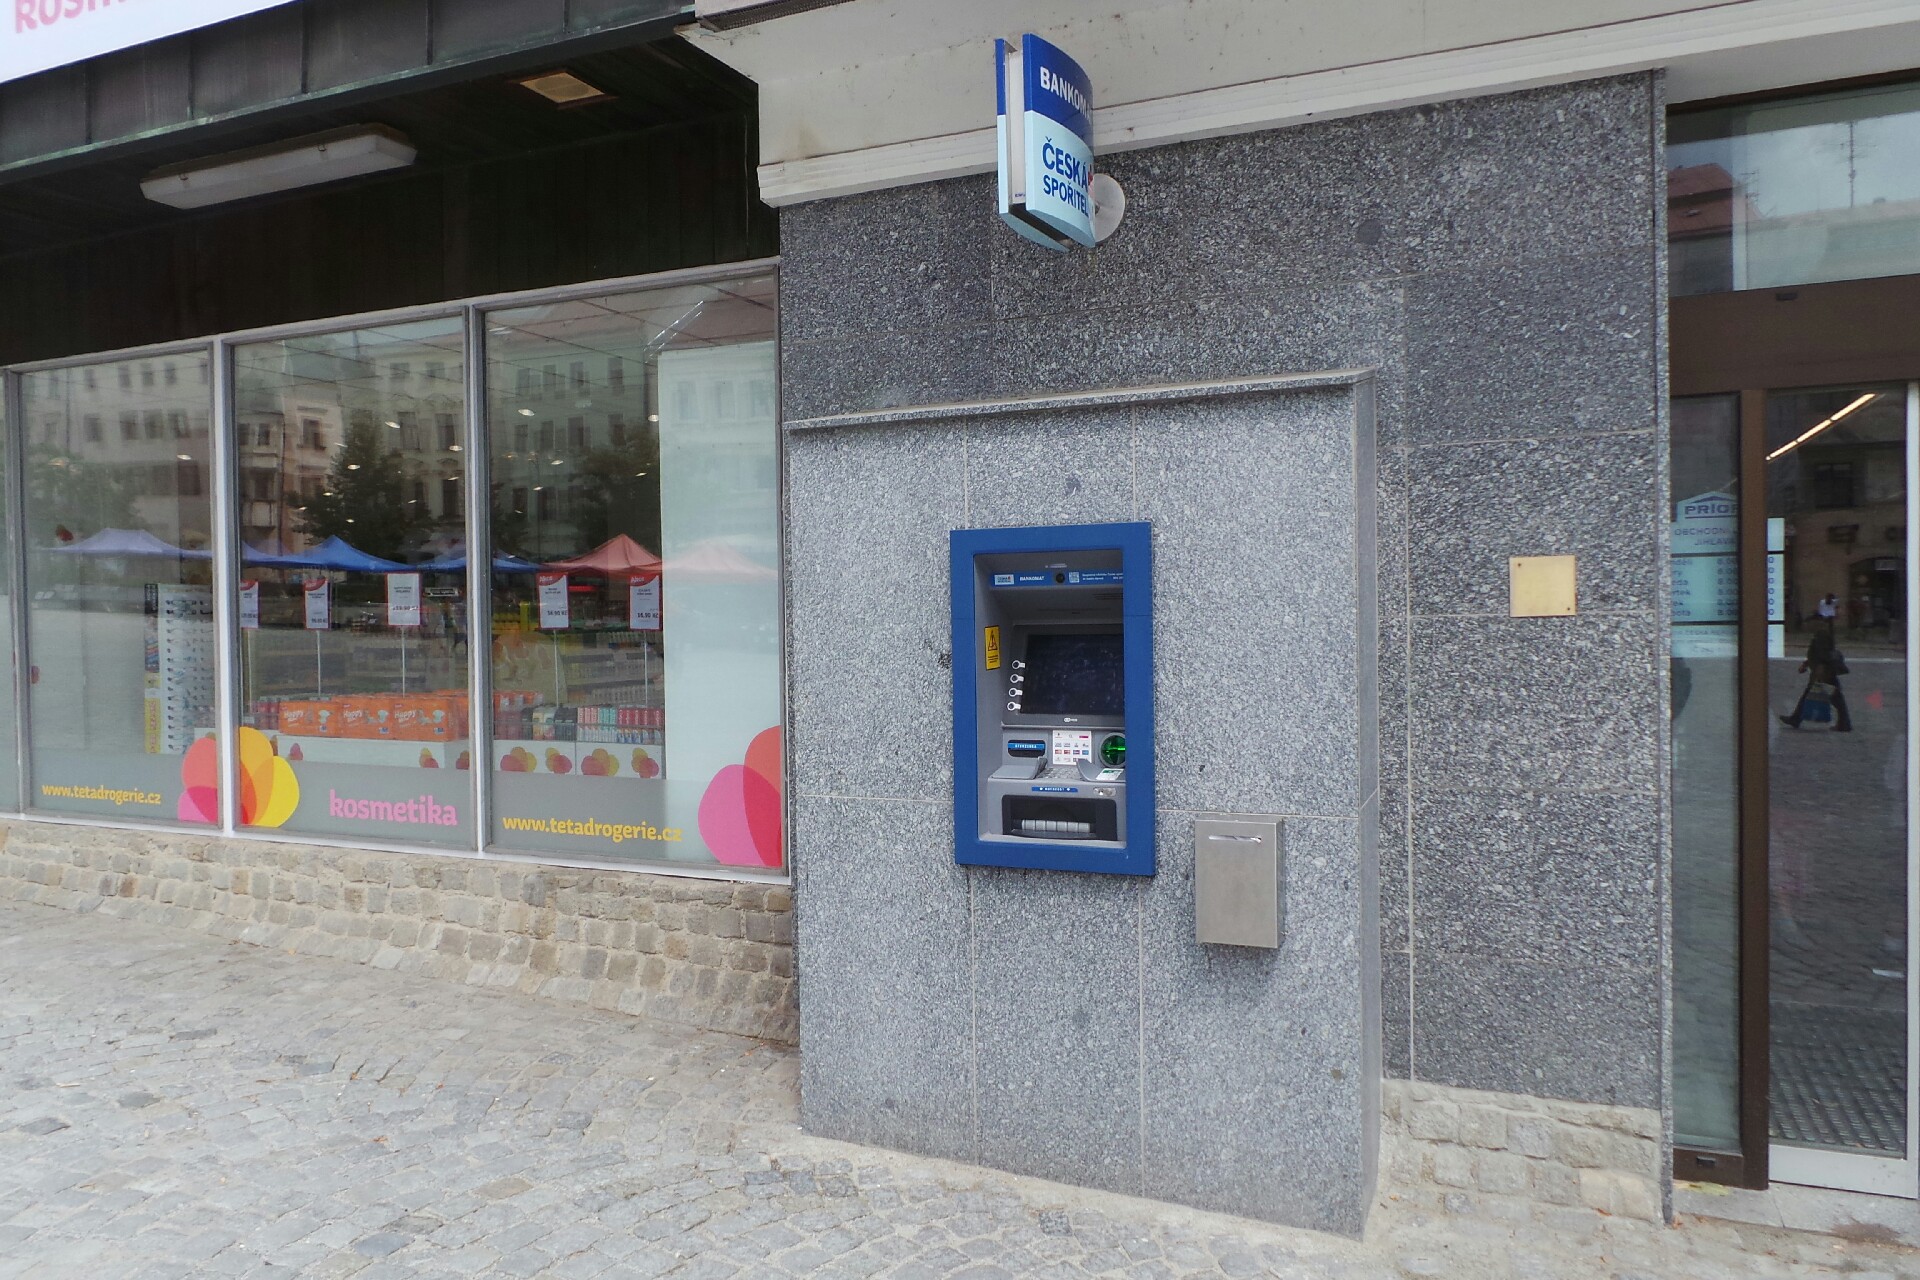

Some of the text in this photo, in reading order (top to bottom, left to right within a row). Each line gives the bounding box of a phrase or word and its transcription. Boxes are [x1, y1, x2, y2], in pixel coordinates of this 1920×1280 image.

[1039, 66, 1091, 122] BANKOMA
[1042, 136, 1088, 193] ČESKÁ
[1043, 174, 1089, 218] SPOŘITEL
[41, 784, 161, 805] www.tetadrogerie.cz
[502, 817, 682, 843] www.tetadrogerie.cz
